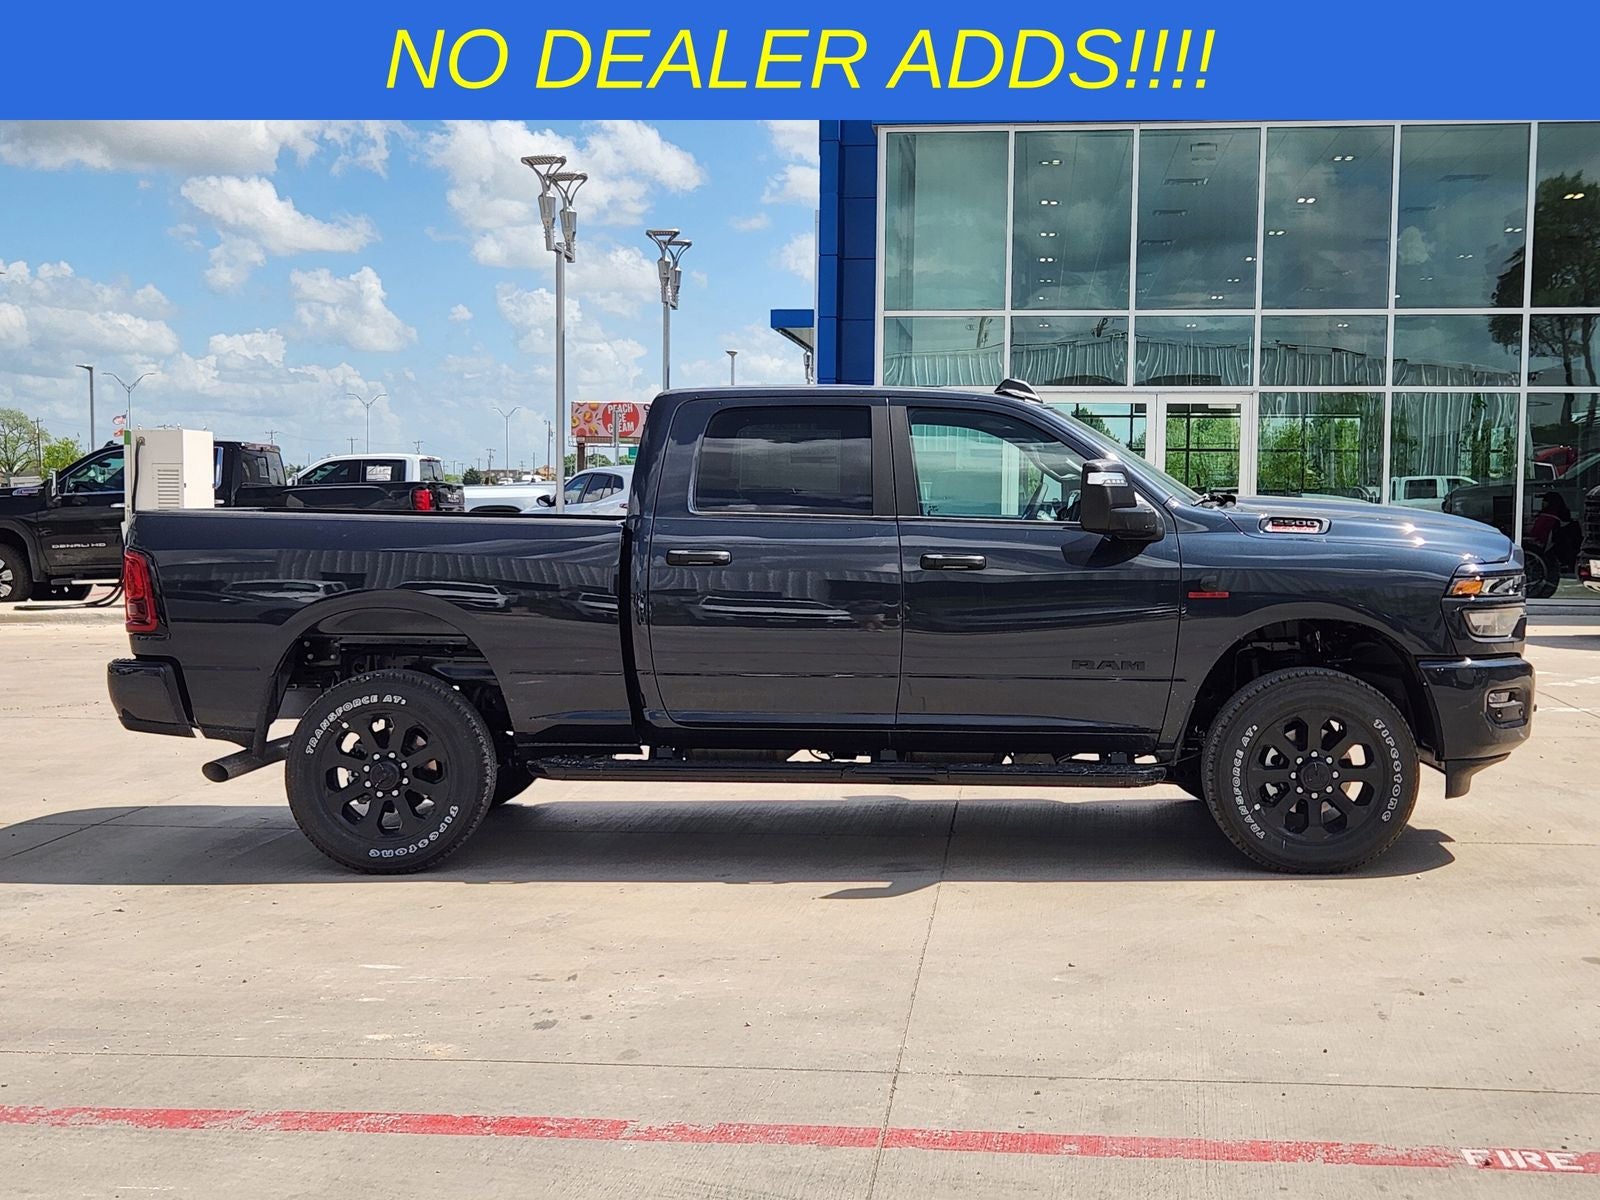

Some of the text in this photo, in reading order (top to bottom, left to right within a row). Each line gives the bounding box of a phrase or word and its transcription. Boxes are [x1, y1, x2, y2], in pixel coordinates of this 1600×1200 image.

[608, 404, 633, 414] PEACH
[608, 422, 634, 433] CEAM
[1272, 519, 1318, 527] 2500
[1072, 659, 1145, 671] RAM
[305, 694, 379, 755] TRANSFORCE
[1231, 749, 1266, 840] TRANSFORCE
[1460, 1148, 1585, 1171] FIRE
